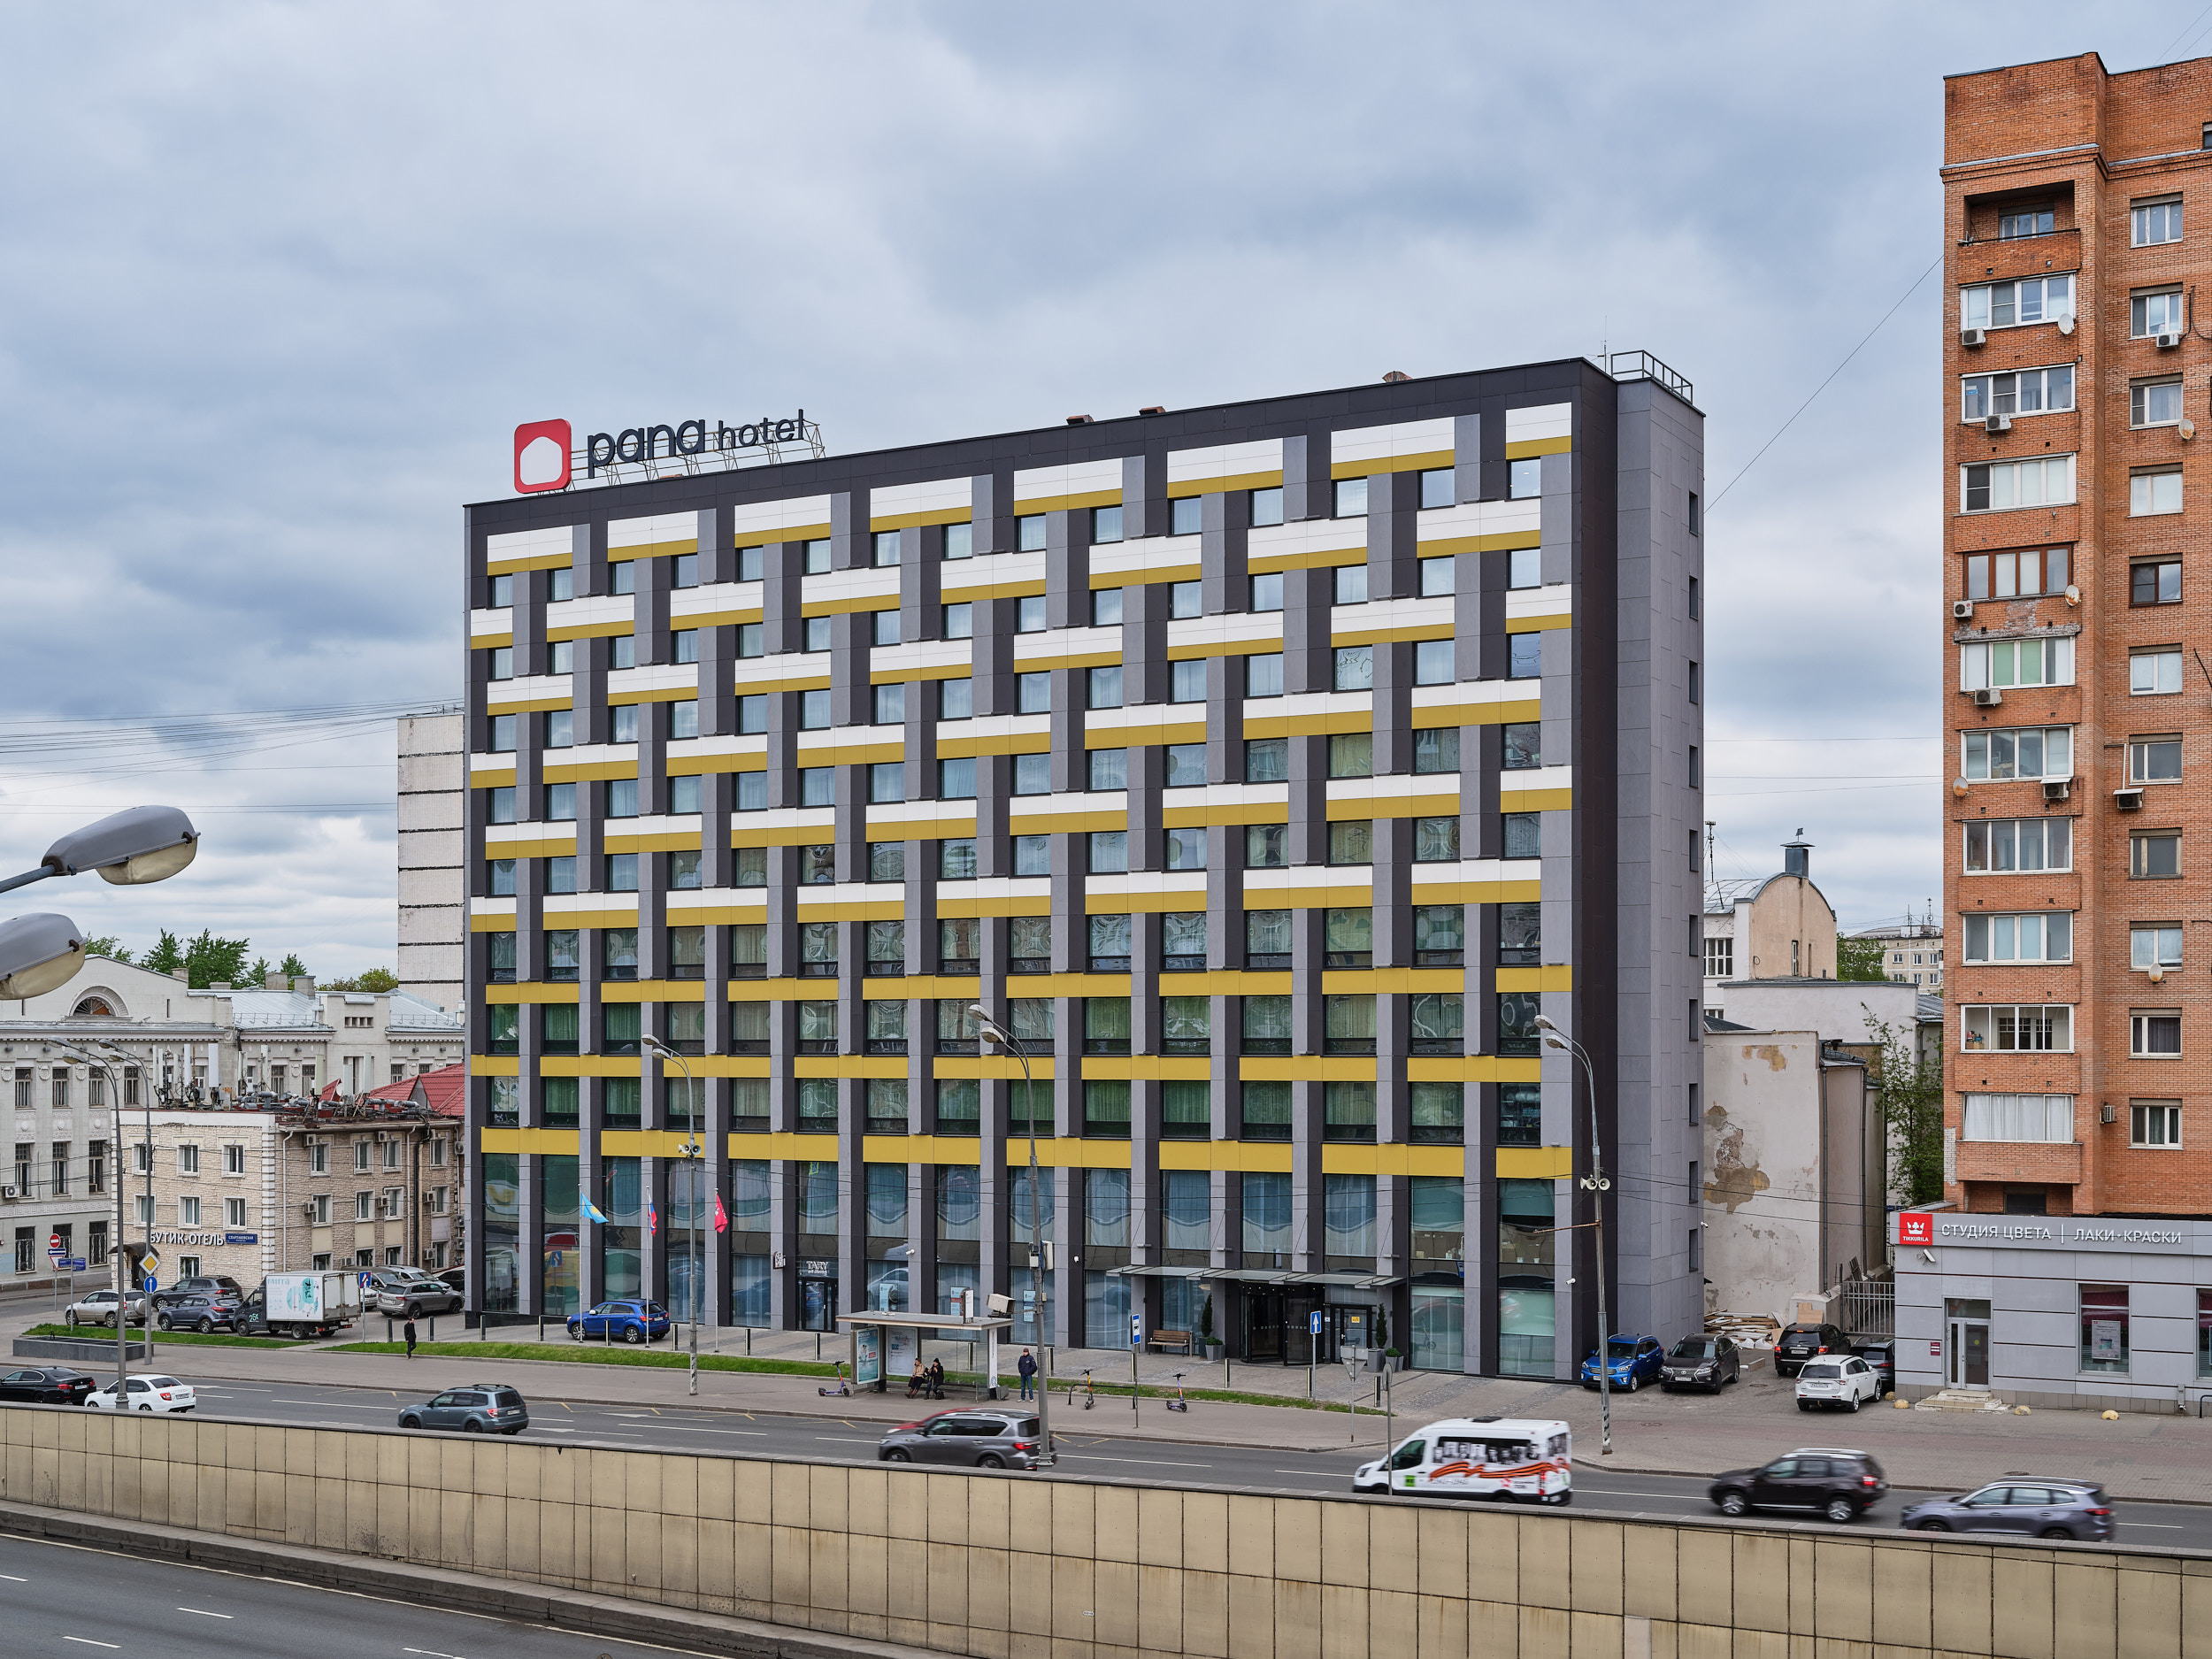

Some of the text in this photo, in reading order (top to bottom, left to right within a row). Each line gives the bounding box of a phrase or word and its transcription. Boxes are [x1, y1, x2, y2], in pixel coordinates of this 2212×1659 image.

[588, 409, 803, 479] pana hotel
[150, 1232, 224, 1246] БУТИК-ОТЕЛЬ
[1941, 1224, 1998, 1239] СТУДИЯ
[2003, 1225, 2052, 1240] ЦВЕТА
[806, 1260, 829, 1271] TARY
